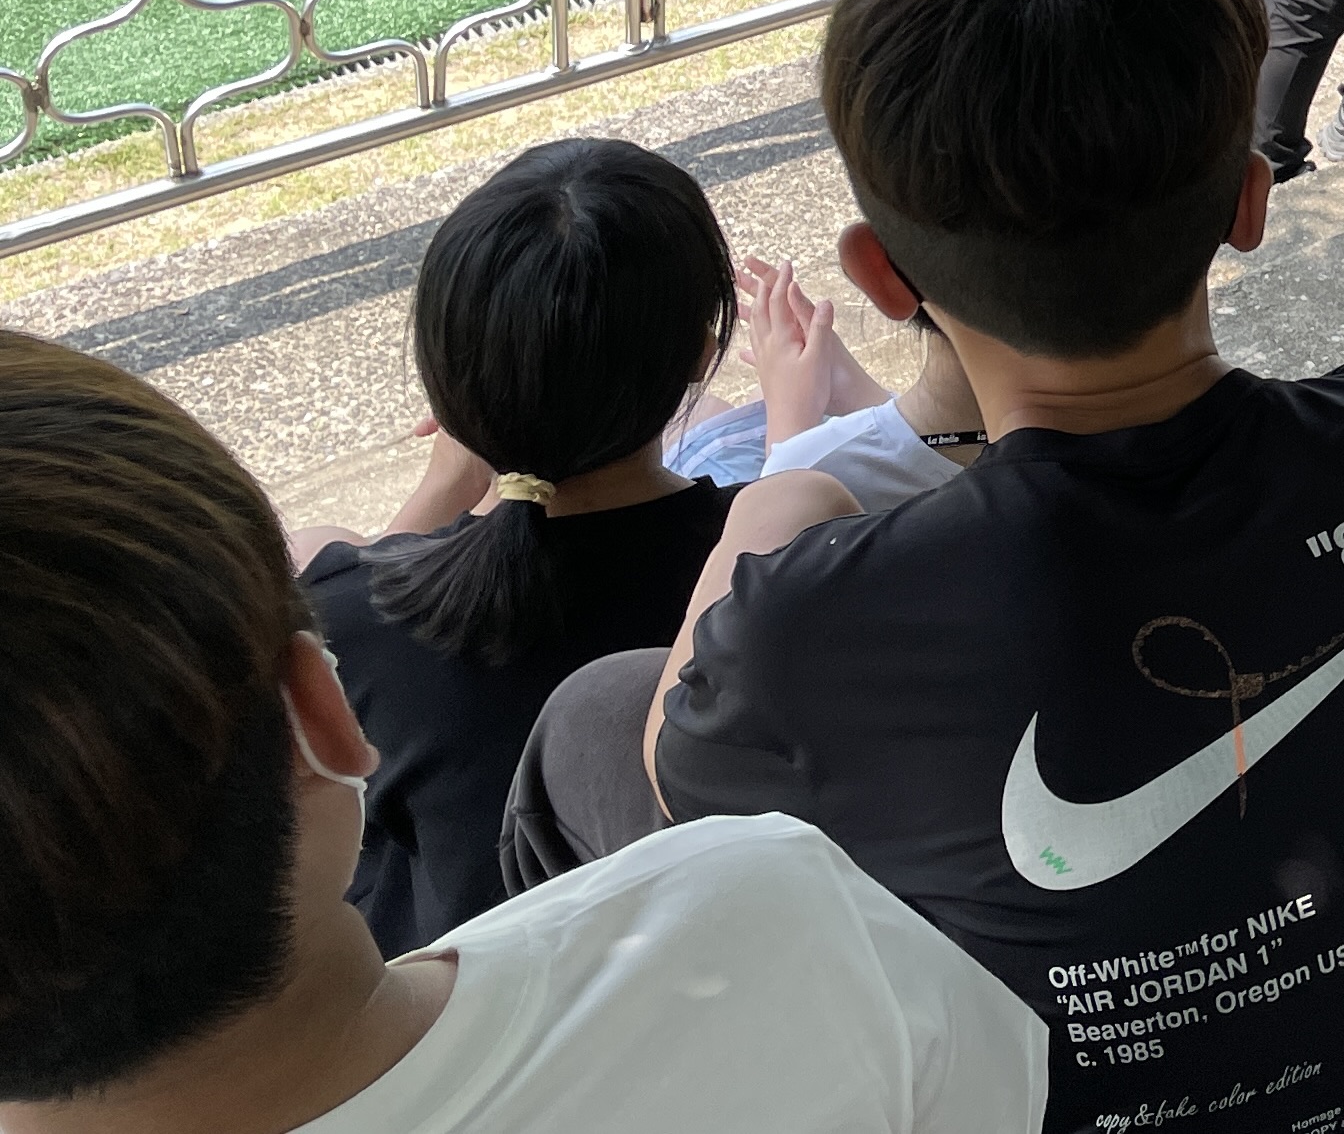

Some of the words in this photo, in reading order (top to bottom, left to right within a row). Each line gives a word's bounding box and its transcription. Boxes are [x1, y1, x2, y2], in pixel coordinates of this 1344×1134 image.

[1199, 928, 1239, 957] for
[1246, 893, 1317, 940] NIKE
[1067, 1007, 1209, 1044] Beaverton,
[1215, 964, 1312, 1015] Oregon
[1123, 953, 1249, 1007] JORDAN
[1075, 1050, 1098, 1068] c.
[1103, 1039, 1165, 1065] 1985
[1208, 1082, 1258, 1113] color
[1265, 1061, 1323, 1095] edition
[1291, 1106, 1342, 1133] Homage
[1304, 1121, 1338, 1134] OPY
